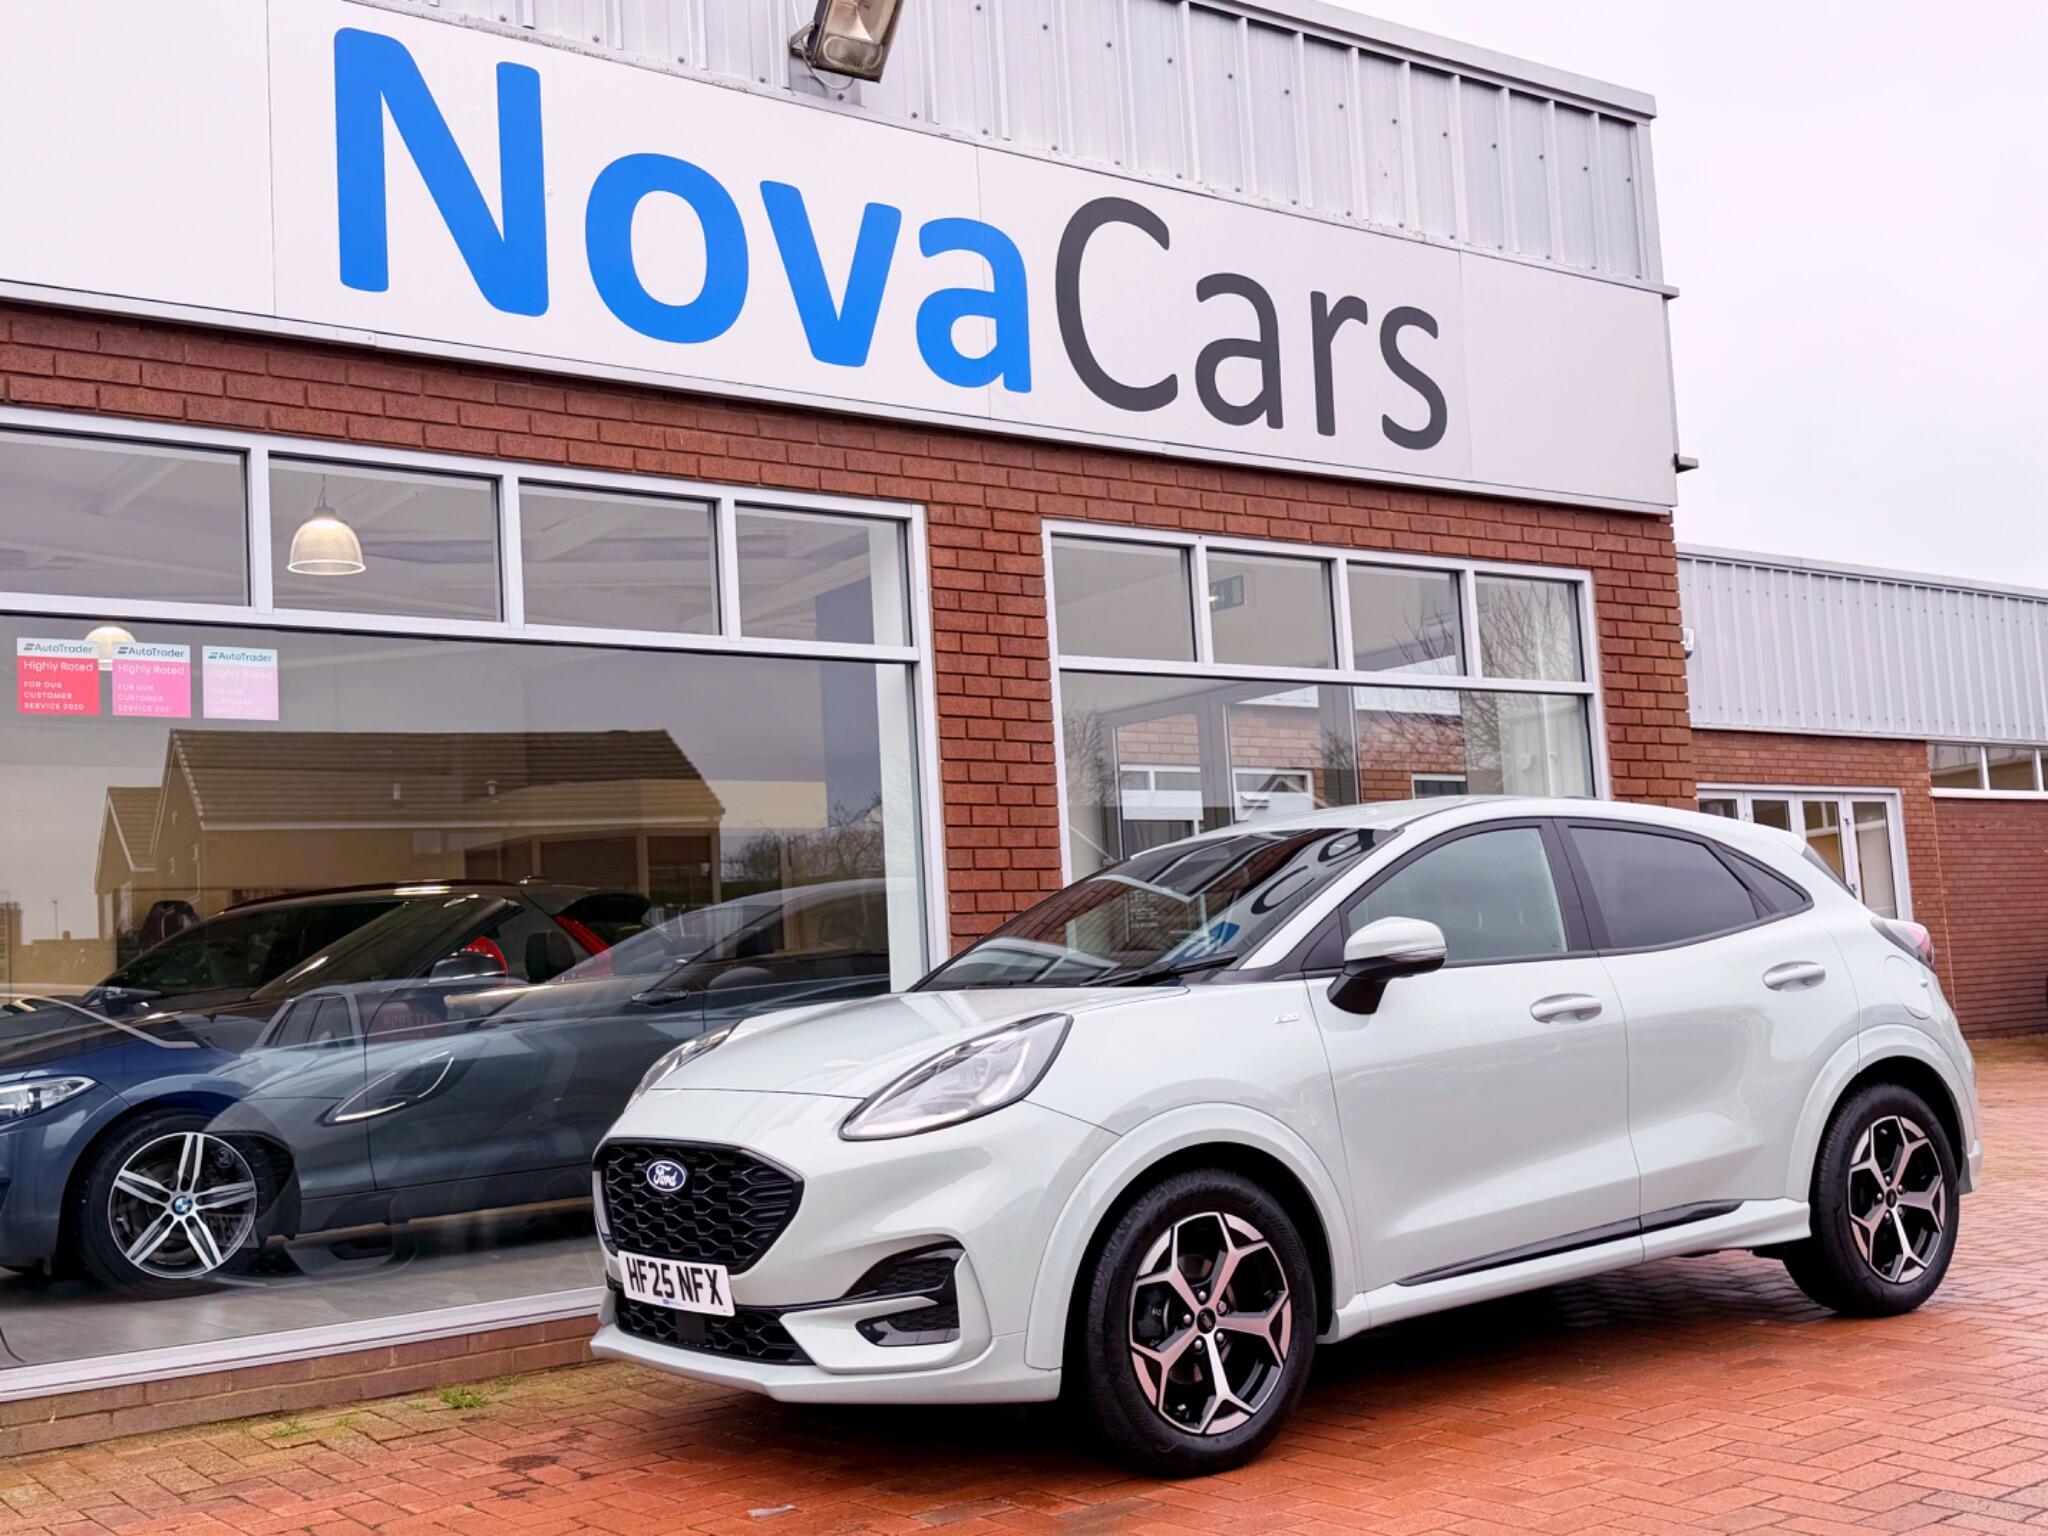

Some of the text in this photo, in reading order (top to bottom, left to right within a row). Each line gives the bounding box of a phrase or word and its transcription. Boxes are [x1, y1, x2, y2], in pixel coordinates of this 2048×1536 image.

[334, 27, 1447, 449] NovaCars
[35, 643, 94, 655] AutoTrader
[128, 647, 184, 658] AutoTrader
[219, 652, 272, 664] AutoTrader
[24, 660, 94, 673] Highly Rated
[118, 663, 184, 676] Highly Rated
[24, 681, 62, 690] FOR OUR
[24, 691, 72, 700] CUSTOMER
[24, 701, 60, 711] SERVICE
[653, 1164, 678, 1187] Ford
[626, 1256, 723, 1306] HF25 NFX
